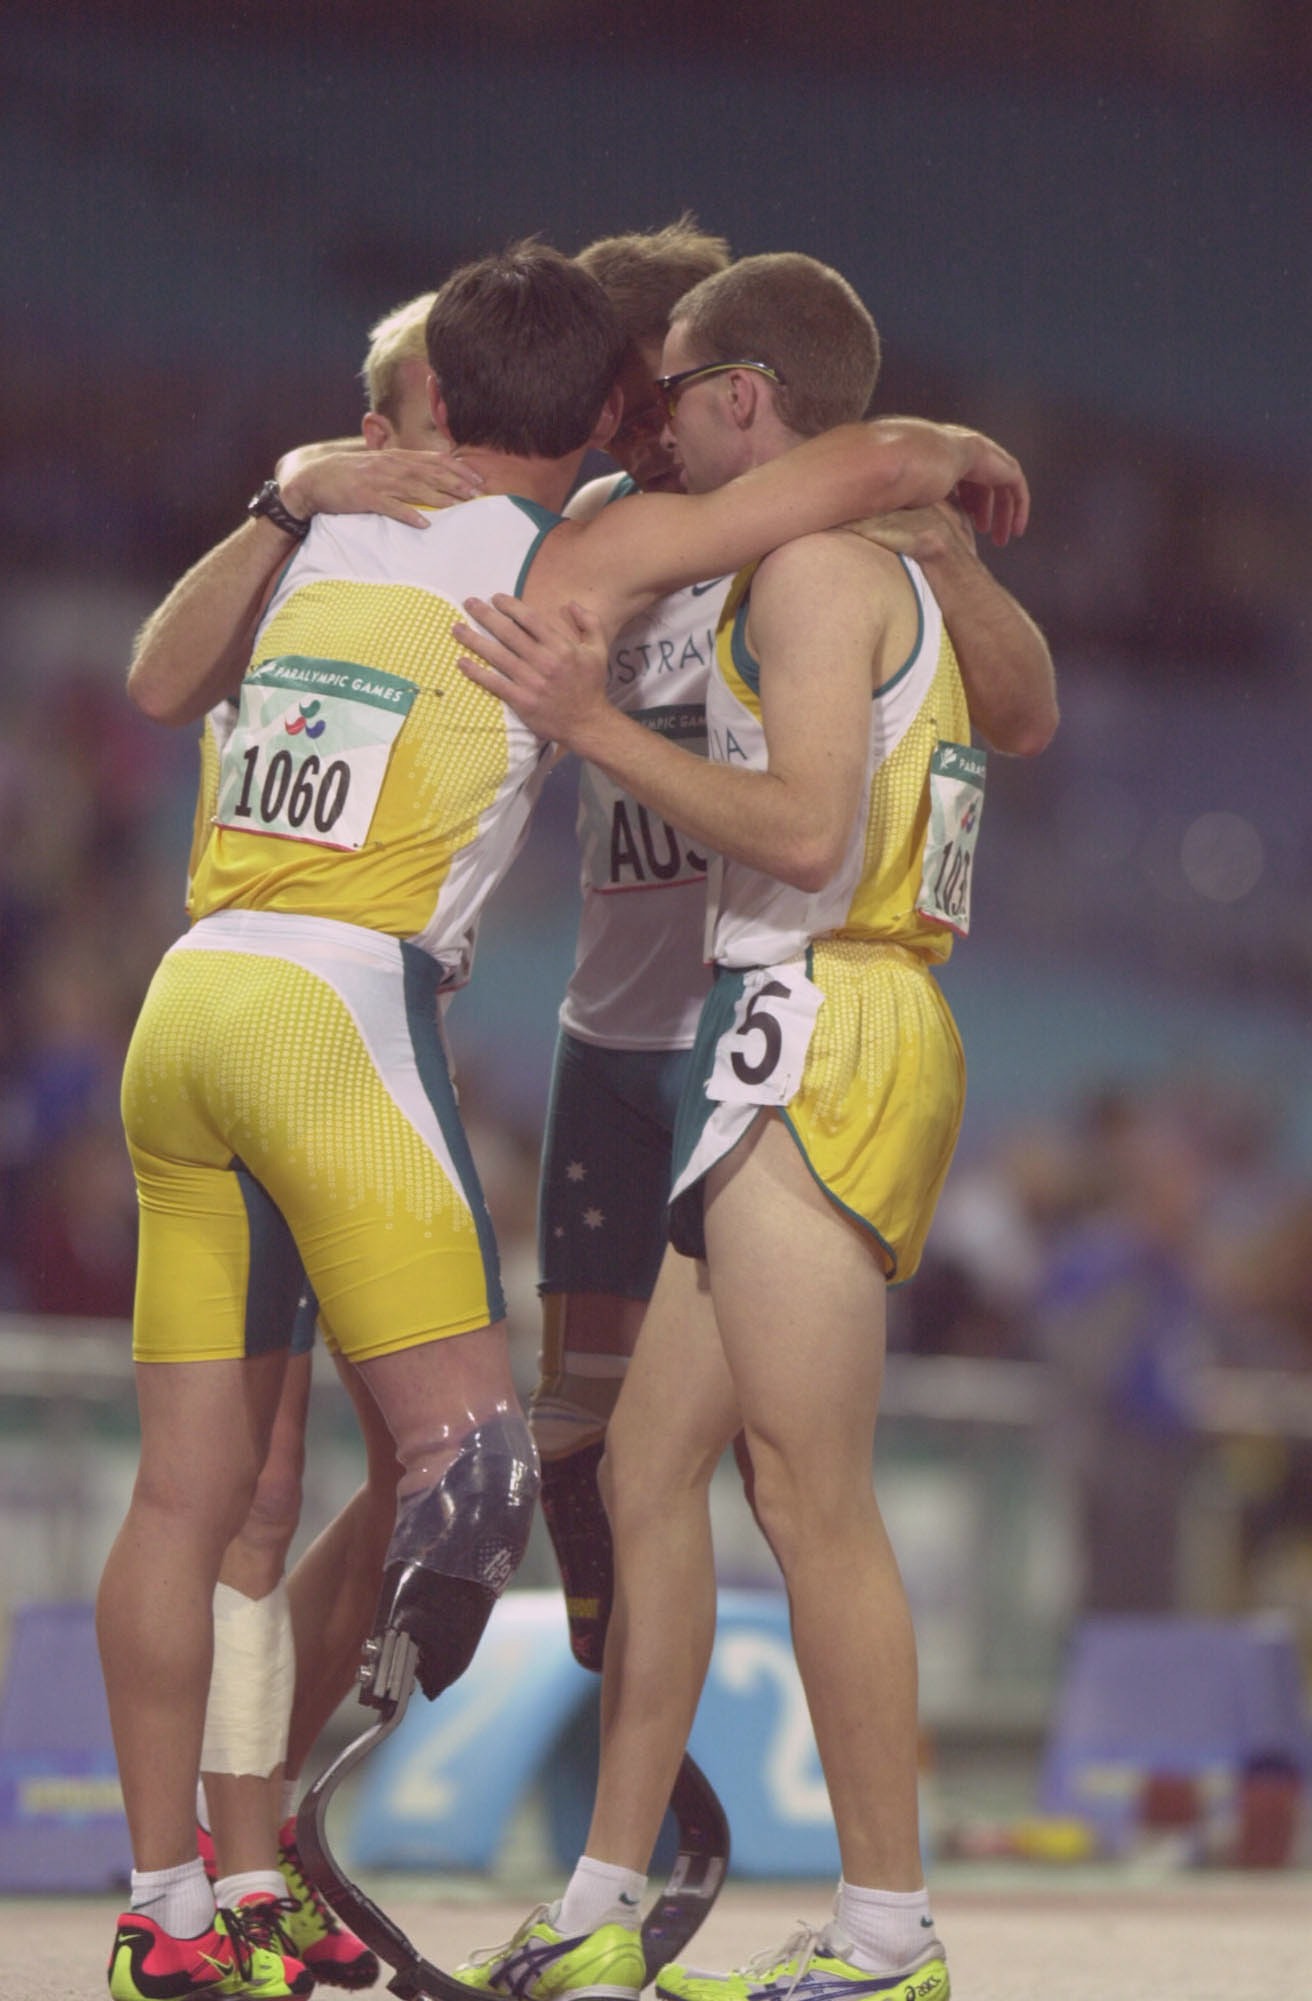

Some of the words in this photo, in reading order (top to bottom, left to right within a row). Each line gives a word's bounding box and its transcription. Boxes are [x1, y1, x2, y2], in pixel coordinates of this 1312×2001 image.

[275, 664, 348, 687] PARALYMPIC
[351, 678, 404, 702] GAMES
[234, 745, 351, 833] 1060
[731, 980, 792, 1086] 5
[717, 1632, 834, 1826] 2
